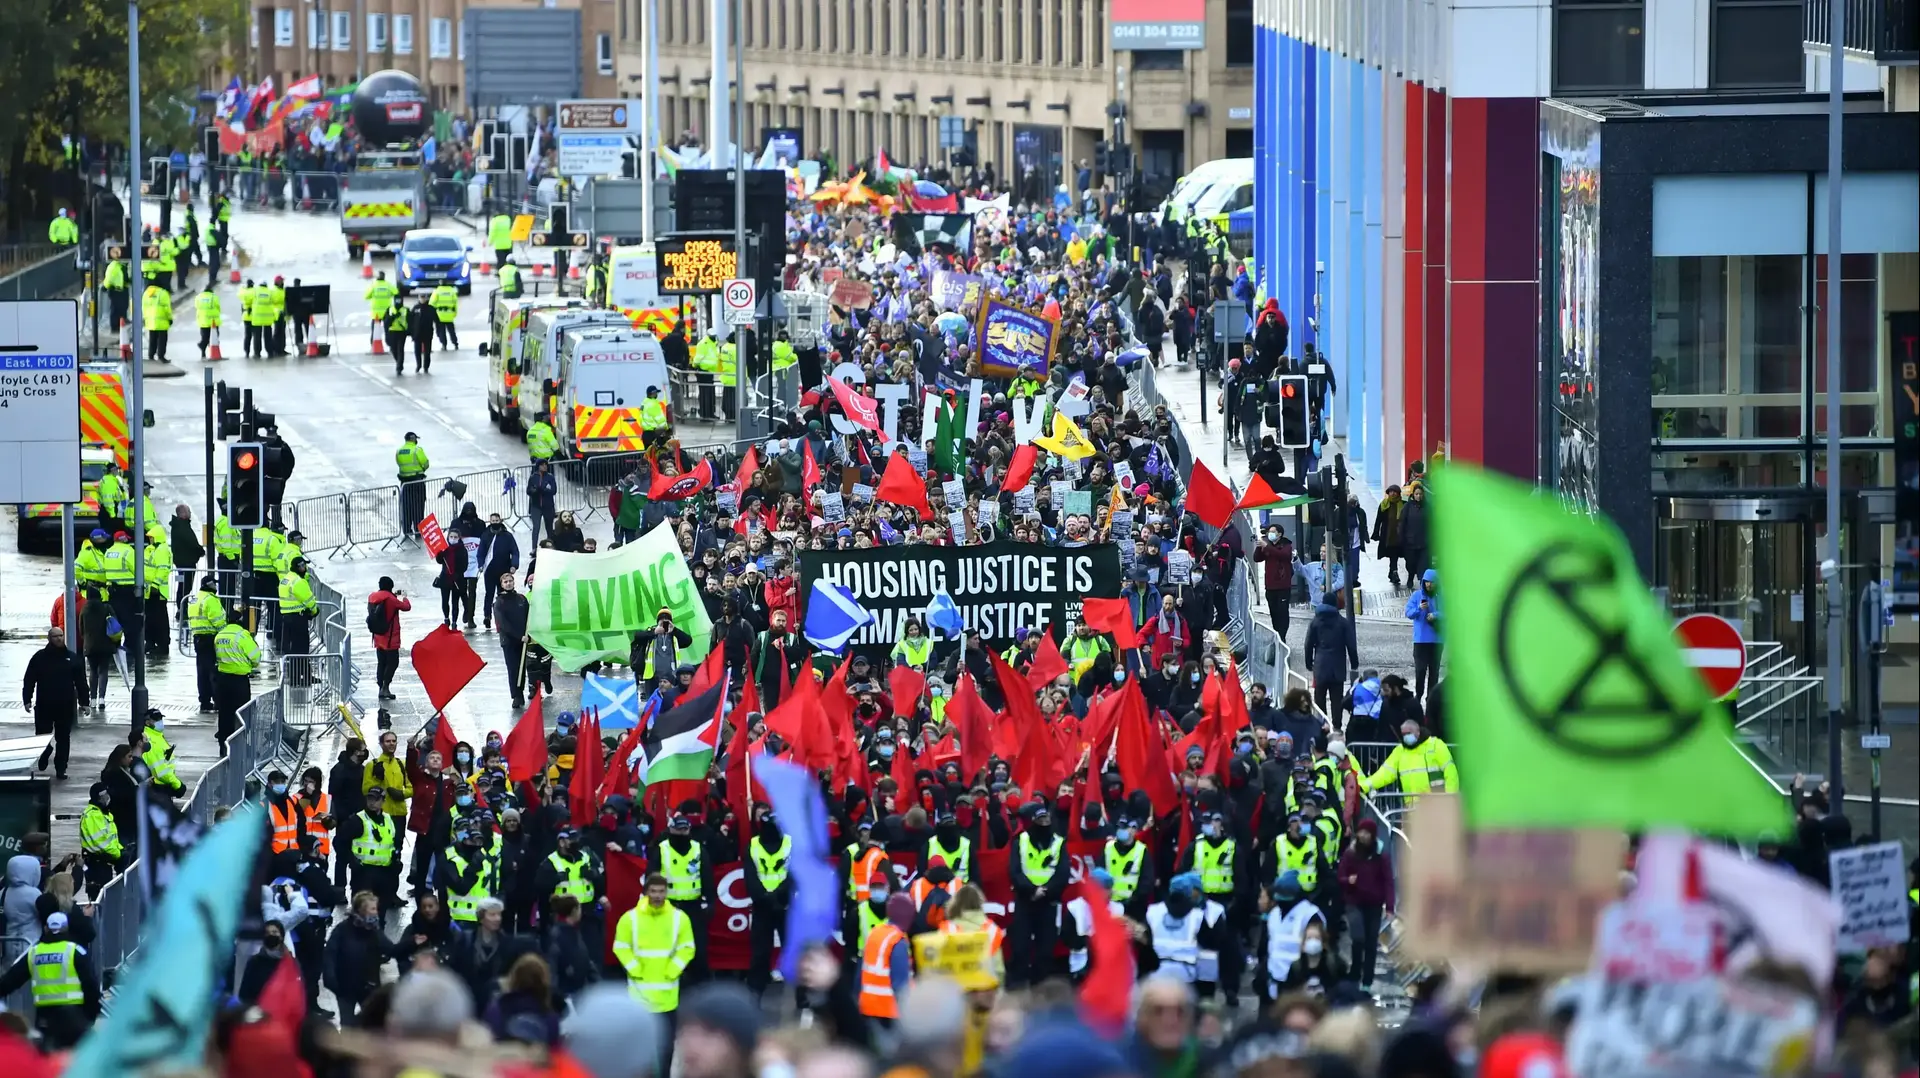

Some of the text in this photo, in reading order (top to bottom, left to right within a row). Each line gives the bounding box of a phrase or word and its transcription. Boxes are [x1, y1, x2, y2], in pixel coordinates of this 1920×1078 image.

[685, 241, 721, 254] COP26
[664, 252, 736, 266] PROCESSION
[626, 271, 657, 279] POLI
[673, 264, 736, 277] WEST/END
[664, 275, 731, 289] CITY CEN
[941, 280, 964, 295] eis
[730, 289, 748, 300] 30
[5, 357, 33, 368] East,
[581, 352, 655, 363] POLICE
[23, 387, 57, 397] Cross
[81, 384, 103, 393] ICE
[822, 555, 1093, 600] HOUSING JUSTICE IS
[550, 551, 690, 631] LIVING
[1064, 602, 1084, 611] LIVI
[1065, 611, 1084, 620] REN
[35, 953, 64, 966] POLICE
